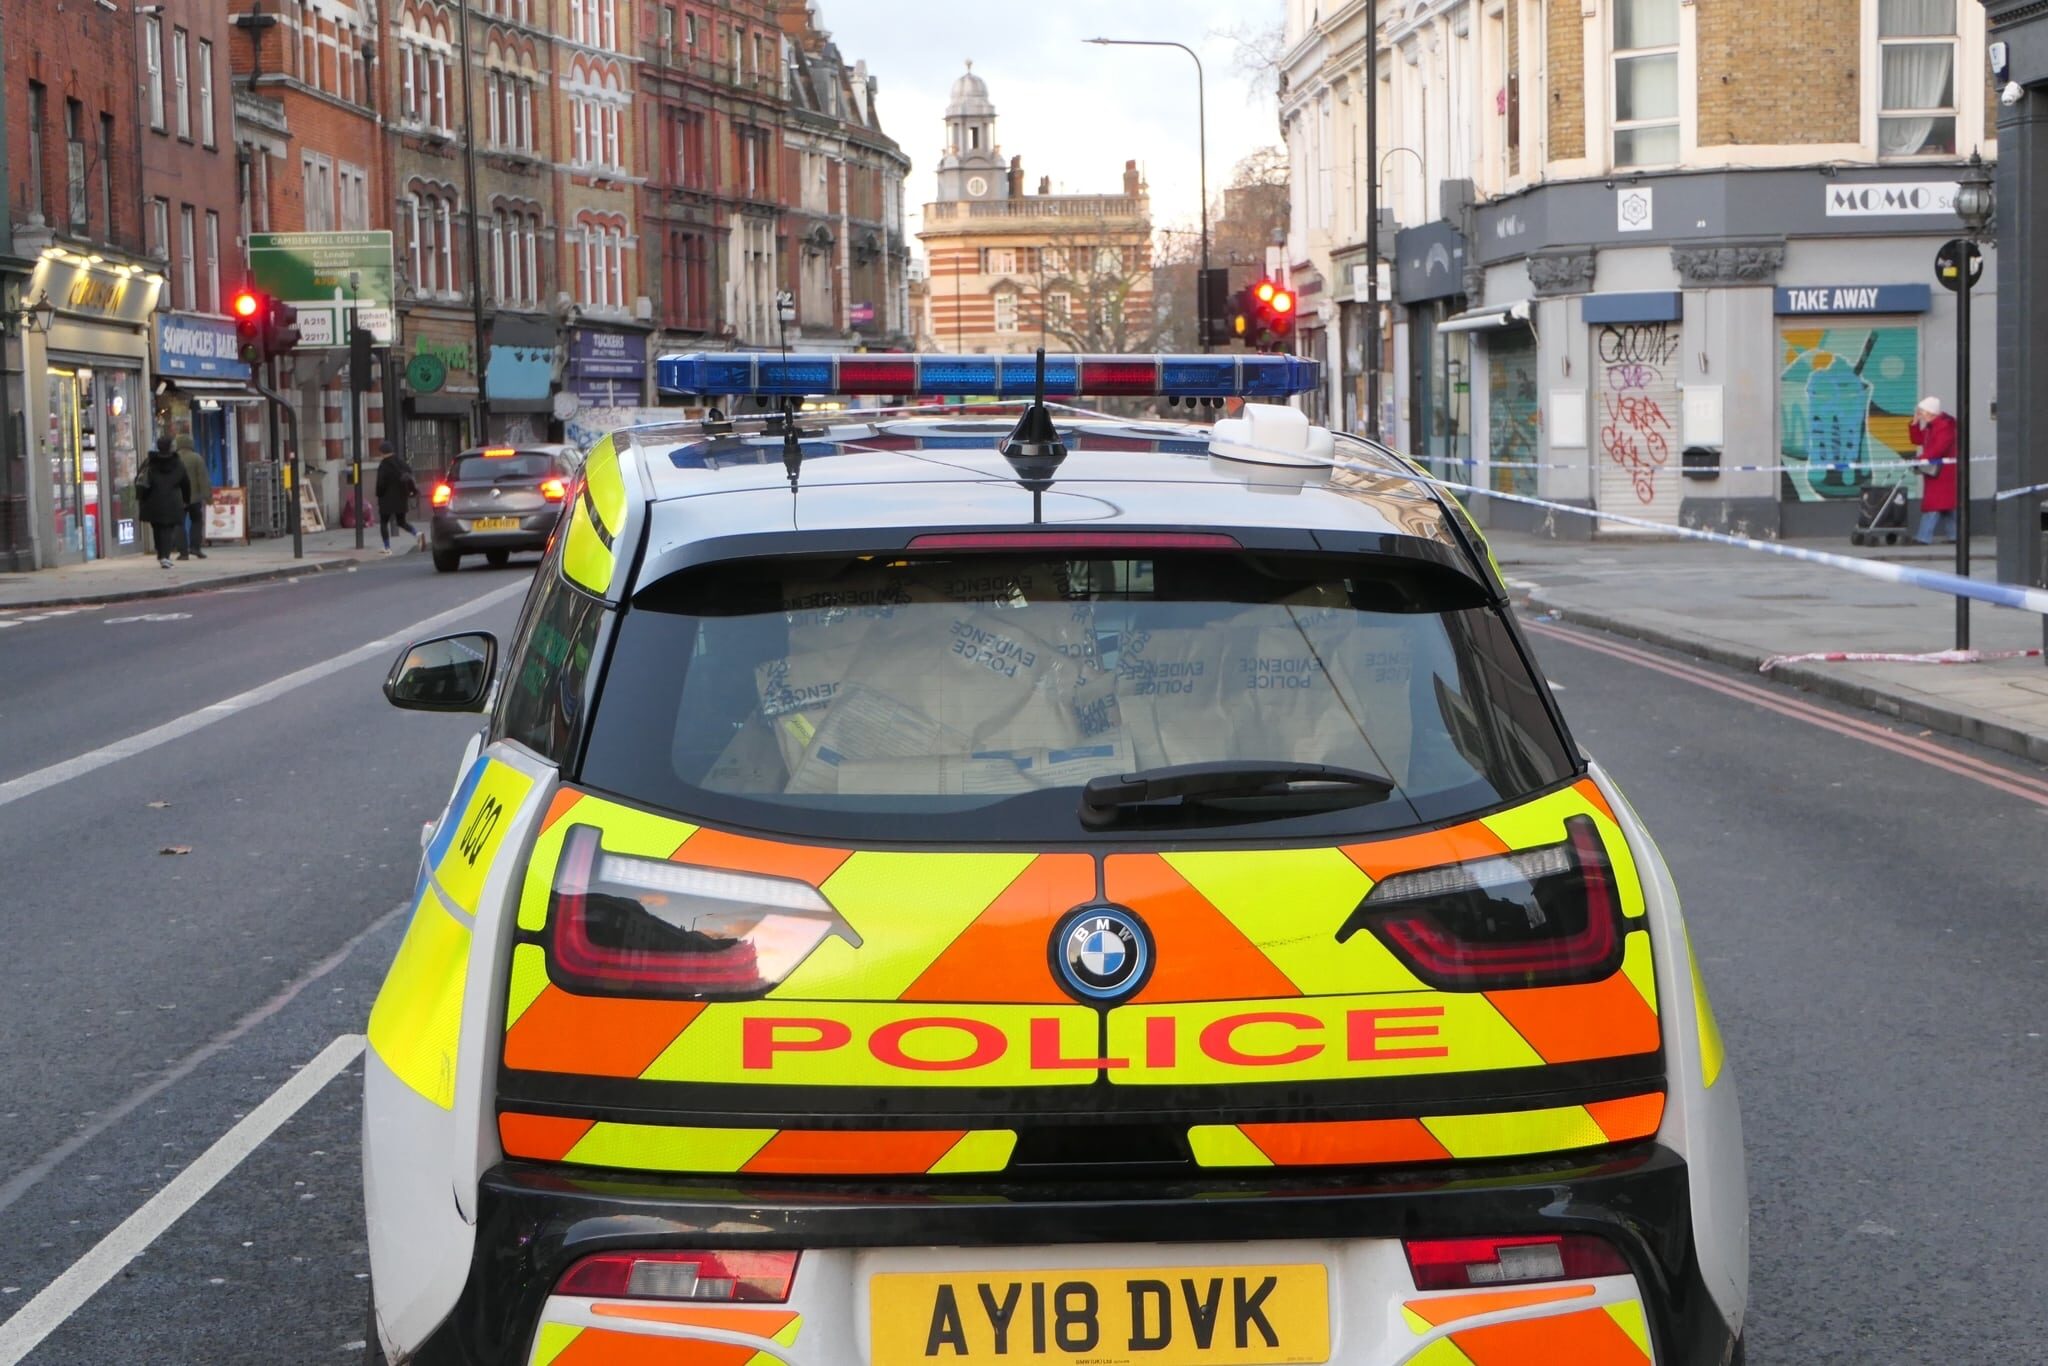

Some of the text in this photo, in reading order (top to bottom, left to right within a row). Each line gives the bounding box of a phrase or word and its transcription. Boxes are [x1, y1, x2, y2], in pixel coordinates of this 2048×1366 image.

[1831, 187, 1931, 211] MOMO
[270, 235, 369, 246] CAMBERWELL GREEN
[1788, 288, 1879, 311] TAKE AWAY
[304, 318, 326, 326] A215
[164, 326, 213, 357] SOPHOCLES
[950, 620, 1036, 667] EVIDENCE
[951, 639, 1017, 678] POLICE
[1239, 657, 1322, 673] EVIDENCE
[1135, 679, 1193, 696] POLICE
[1247, 675, 1311, 690] POLICE
[460, 794, 503, 868] JCQ
[1074, 919, 1133, 942] BMW
[742, 1007, 1448, 1070] POLICE
[925, 1276, 1279, 1356] AY18 DVK
